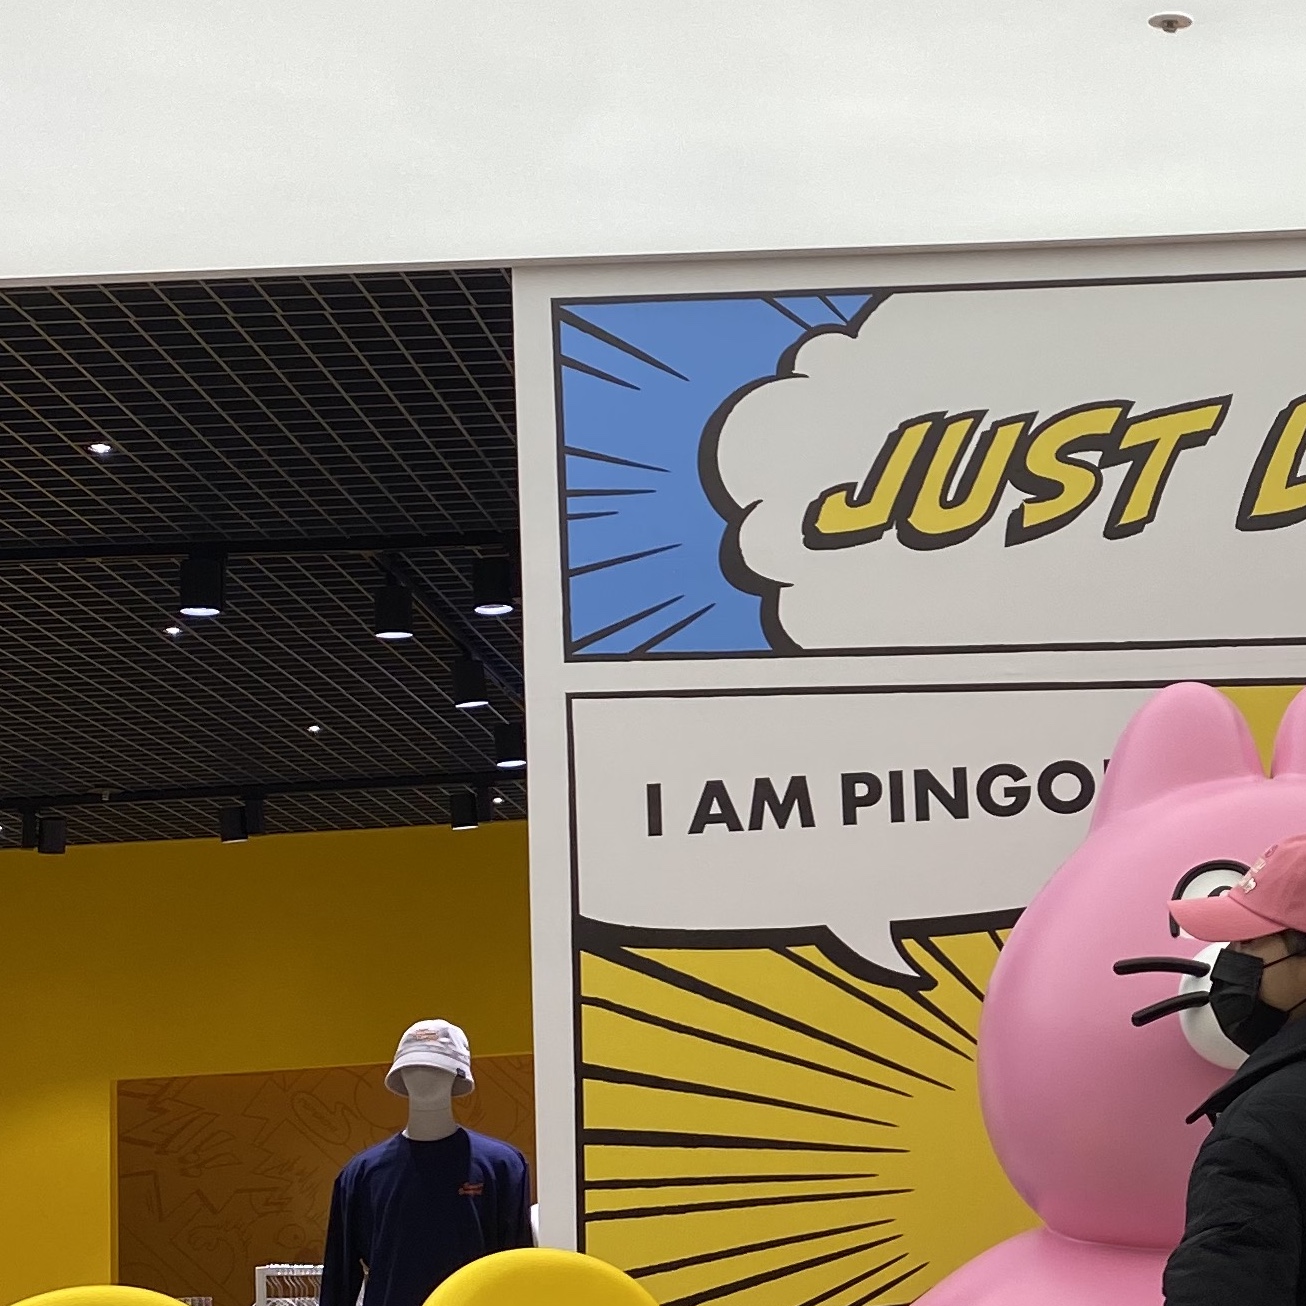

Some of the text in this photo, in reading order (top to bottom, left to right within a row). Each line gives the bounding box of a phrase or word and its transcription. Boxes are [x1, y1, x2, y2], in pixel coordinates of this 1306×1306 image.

[802, 394, 1233, 551] JUST
[646, 758, 1111, 837] I AM PINGO
